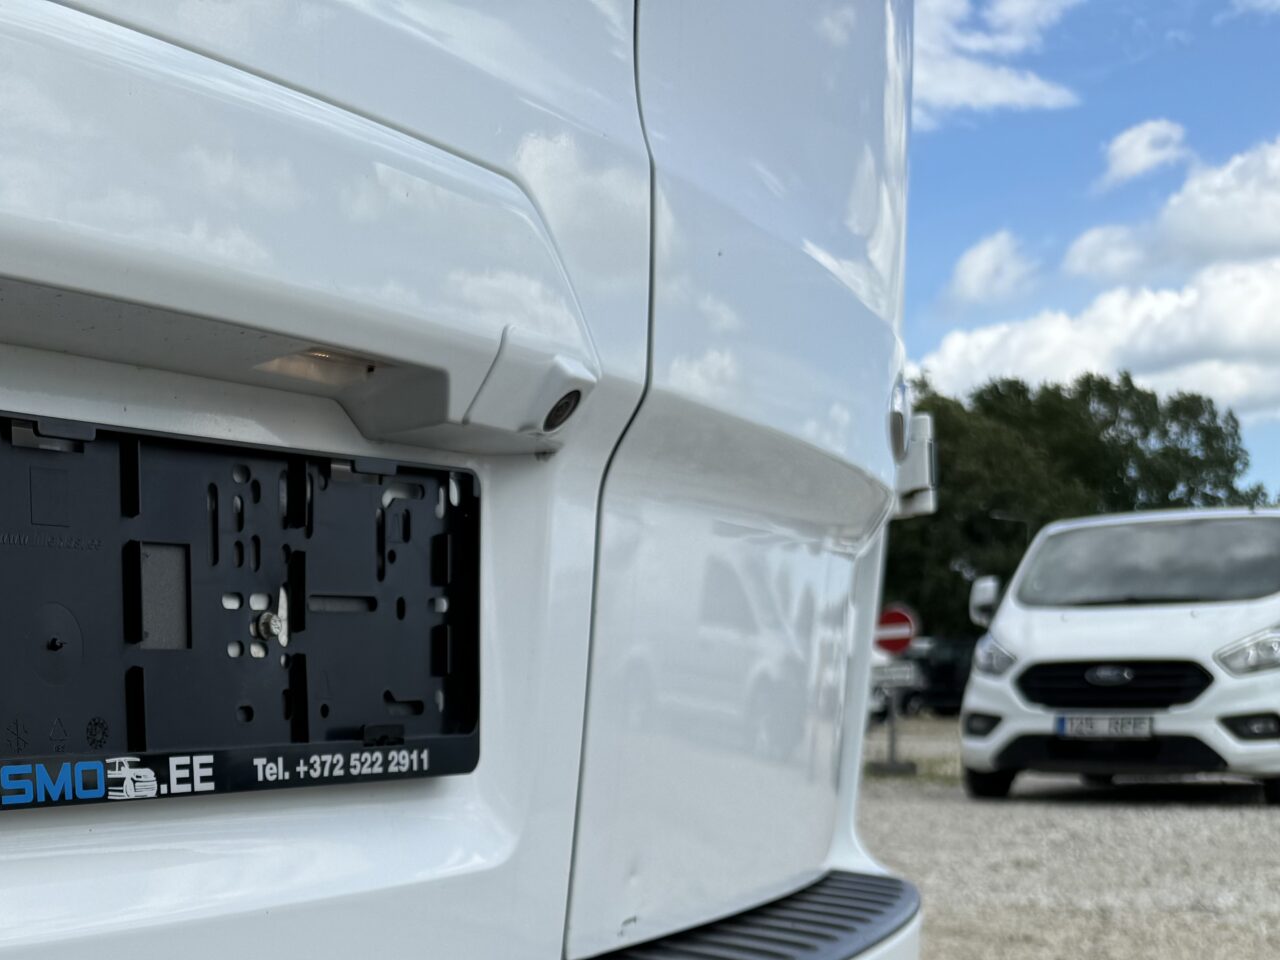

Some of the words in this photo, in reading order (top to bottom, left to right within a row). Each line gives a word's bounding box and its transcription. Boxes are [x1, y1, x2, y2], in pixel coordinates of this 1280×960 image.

[253, 756, 290, 782] Tel.
[295, 753, 345, 779] +372
[349, 751, 384, 776] 522
[387, 749, 428, 774] 2911
